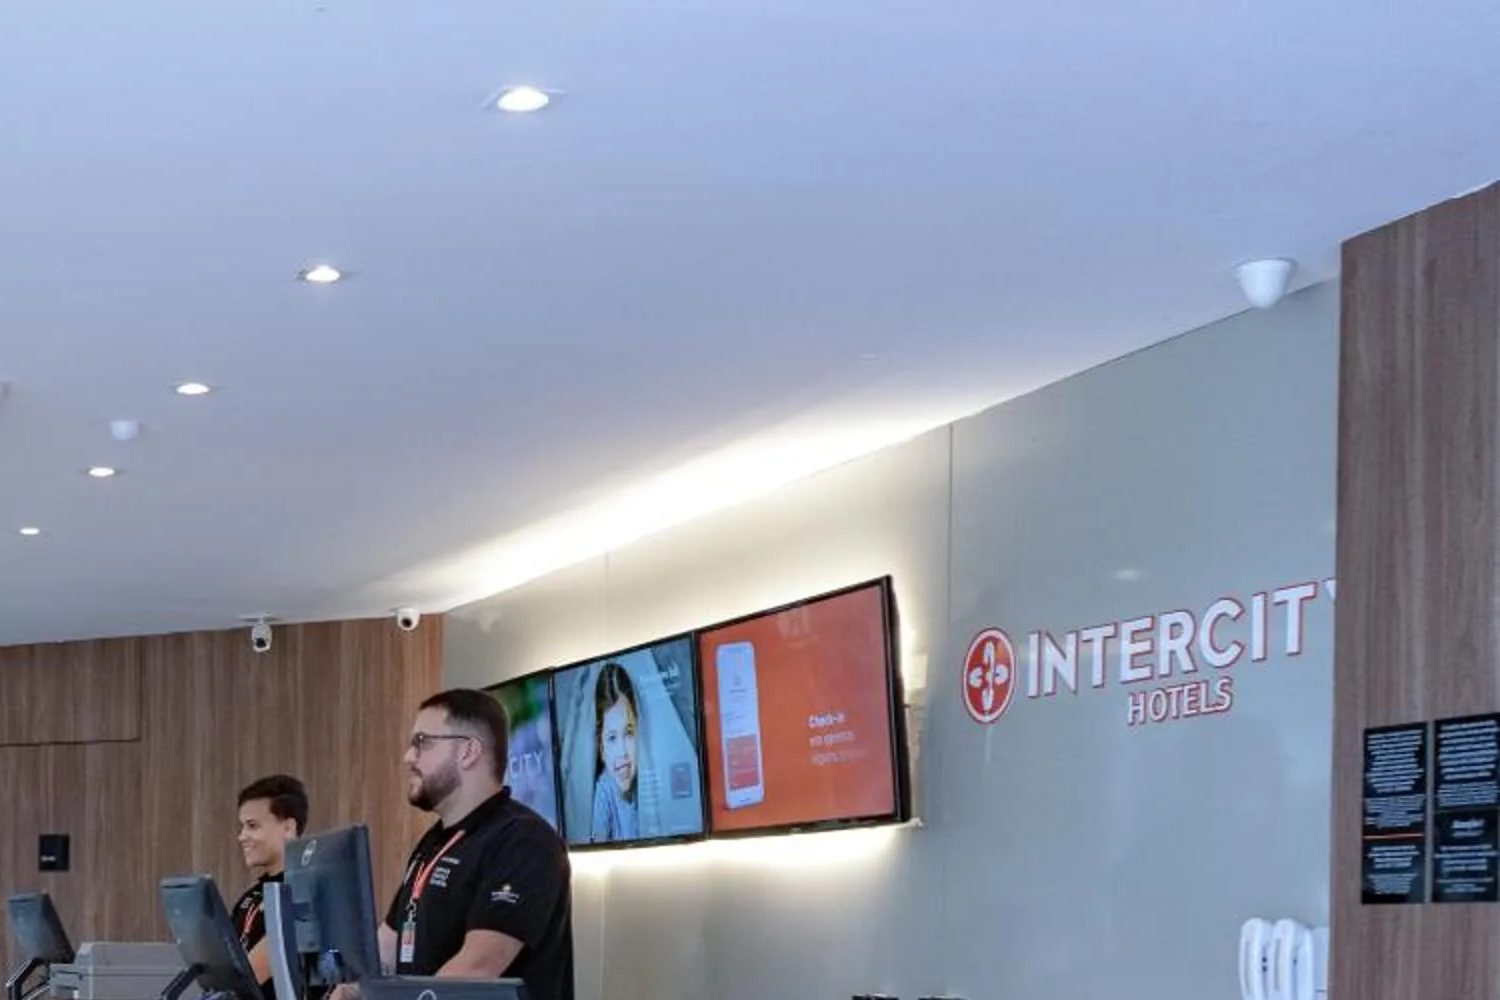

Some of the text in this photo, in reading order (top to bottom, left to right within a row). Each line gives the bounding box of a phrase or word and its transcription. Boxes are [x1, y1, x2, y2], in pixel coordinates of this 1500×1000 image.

[1027, 578, 1336, 698] INTERCIT
[1127, 675, 1233, 726] HOTELS
[510, 751, 543, 778] CITY
